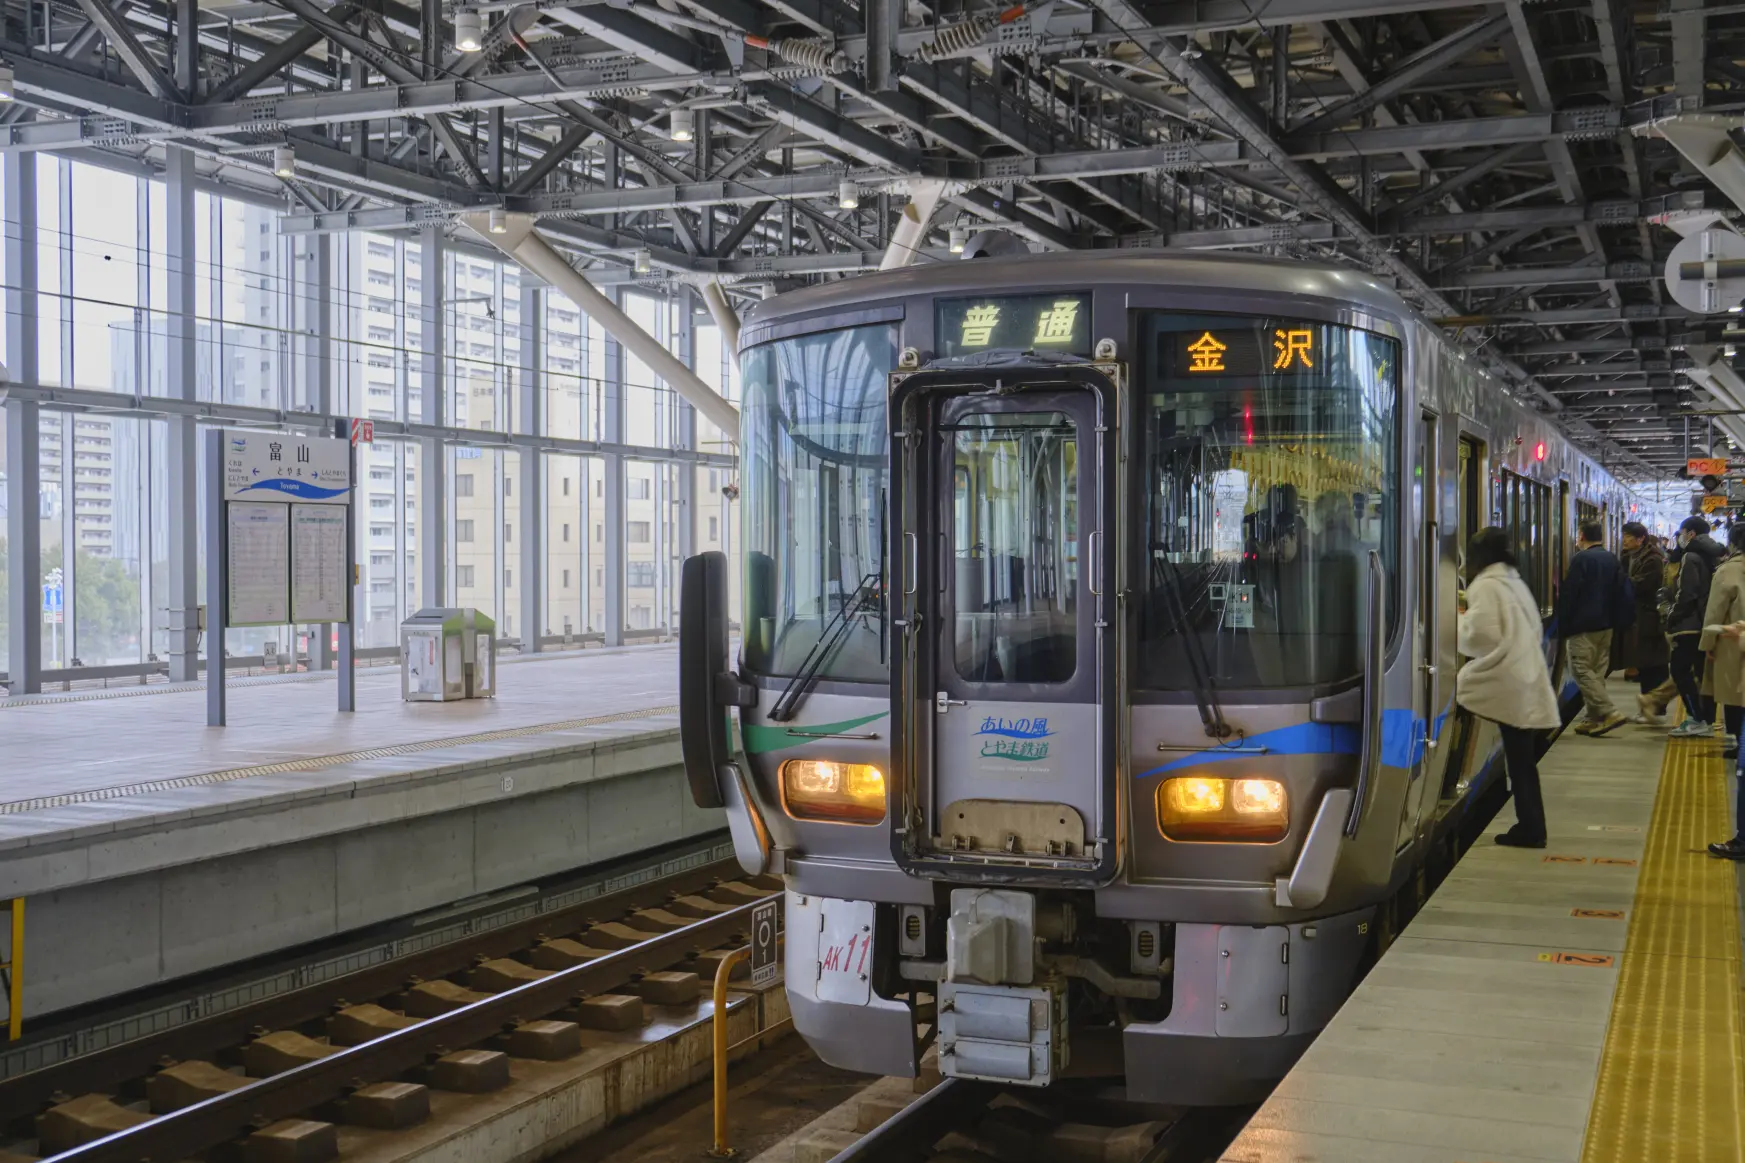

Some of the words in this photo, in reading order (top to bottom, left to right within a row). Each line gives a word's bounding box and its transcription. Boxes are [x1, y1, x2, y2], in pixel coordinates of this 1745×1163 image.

[960, 301, 1080, 346] 普通
[1187, 330, 1313, 371] 金沢
[269, 442, 310, 463] 富山
[277, 467, 302, 476] とやま
[980, 716, 1049, 734] あいの風
[980, 740, 1049, 757] とやま鉄道
